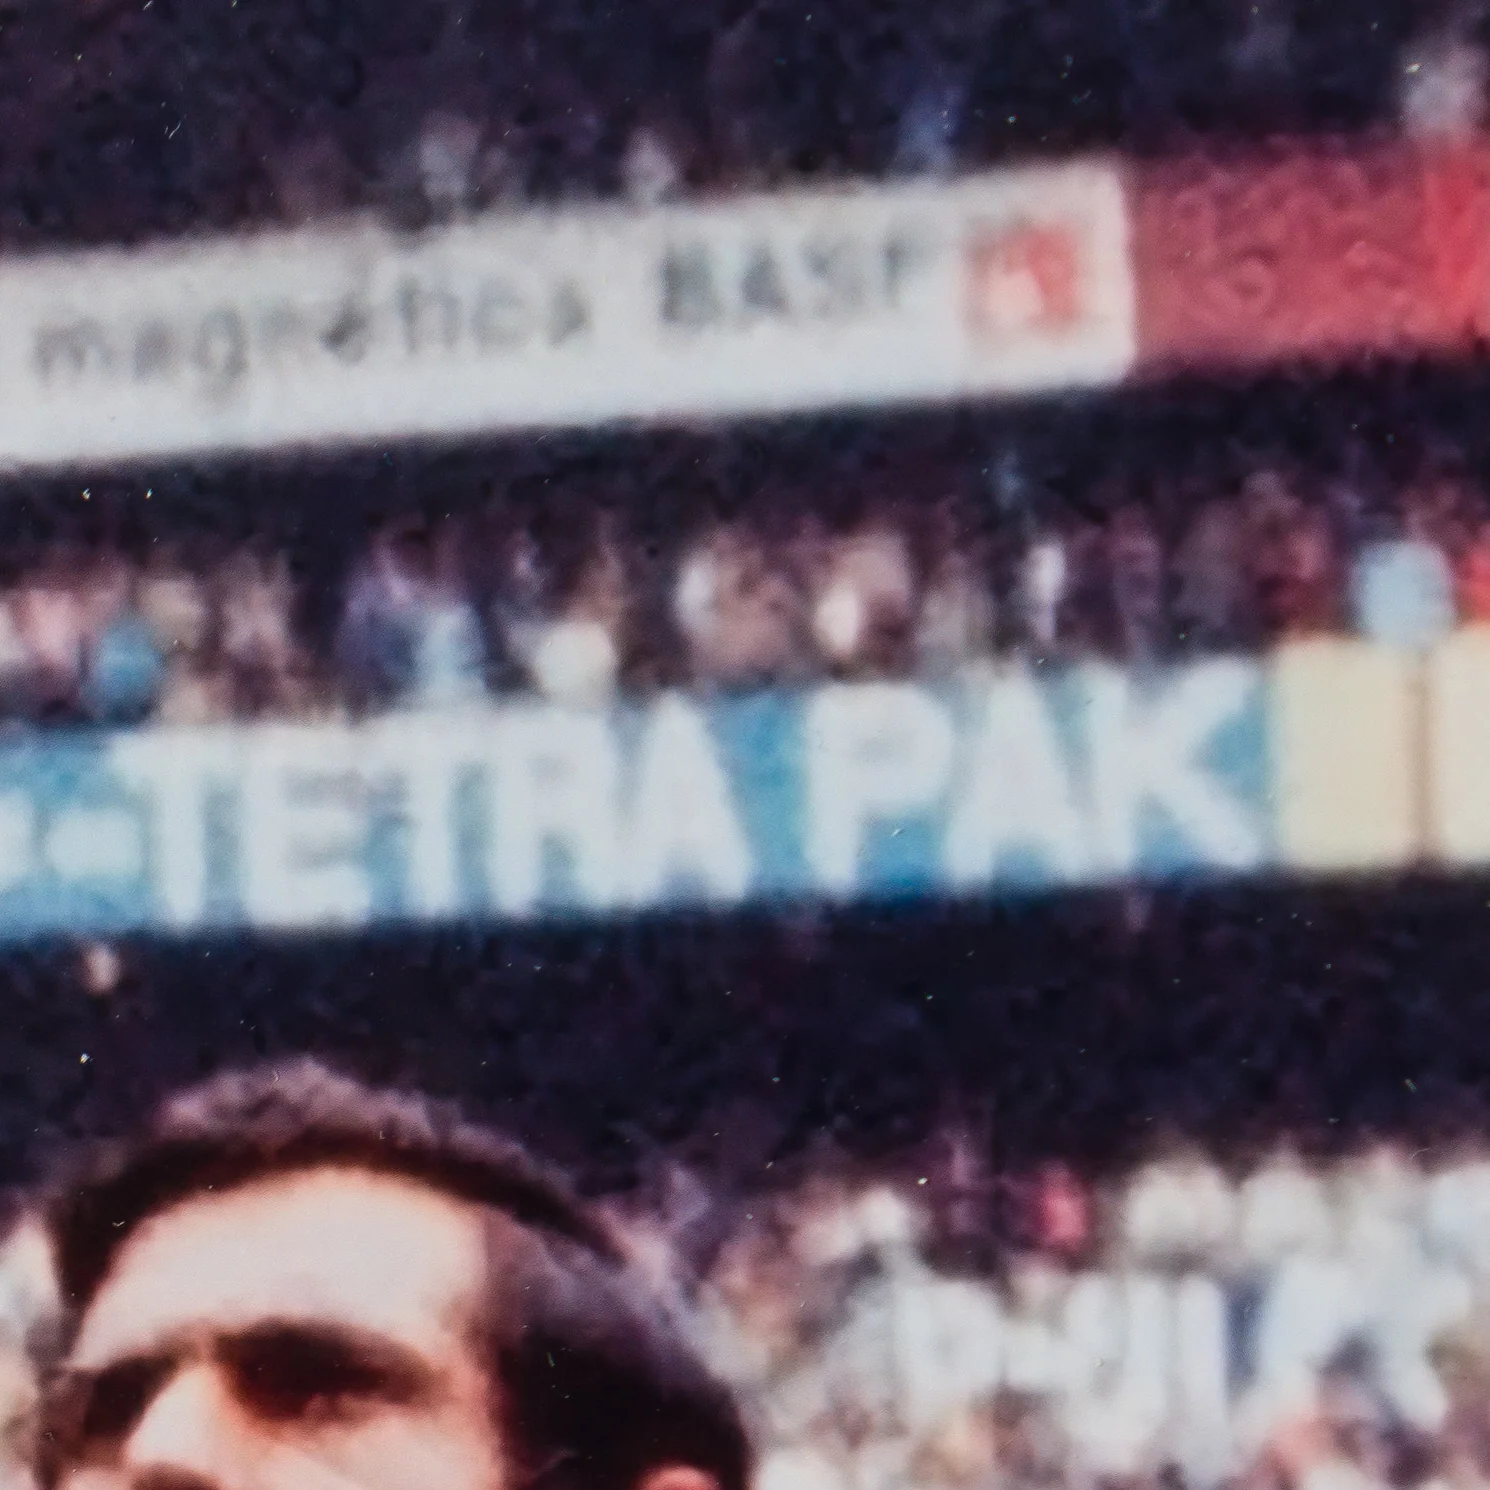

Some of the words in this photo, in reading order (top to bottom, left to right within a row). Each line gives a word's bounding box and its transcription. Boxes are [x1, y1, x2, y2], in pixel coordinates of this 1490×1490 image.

[658, 222, 918, 326] BASF
[105, 688, 755, 926] TETRA
[805, 653, 1265, 900] PAK
